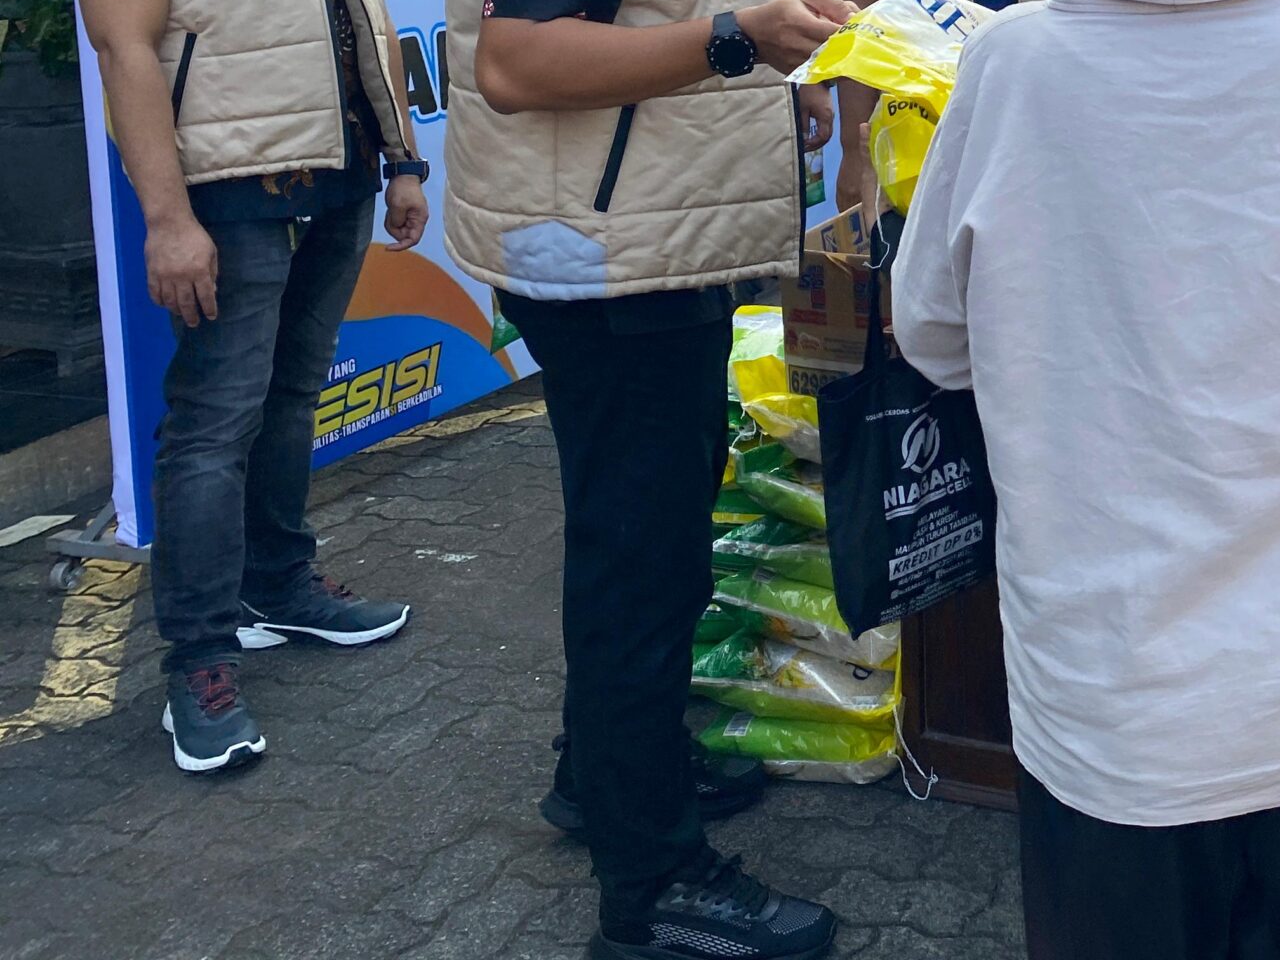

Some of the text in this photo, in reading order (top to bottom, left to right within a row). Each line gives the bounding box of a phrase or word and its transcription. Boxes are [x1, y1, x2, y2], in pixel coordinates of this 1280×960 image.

[883, 457, 971, 509] NIAGARA
[892, 543, 941, 576] KREDIT
[943, 534, 961, 551] DP
